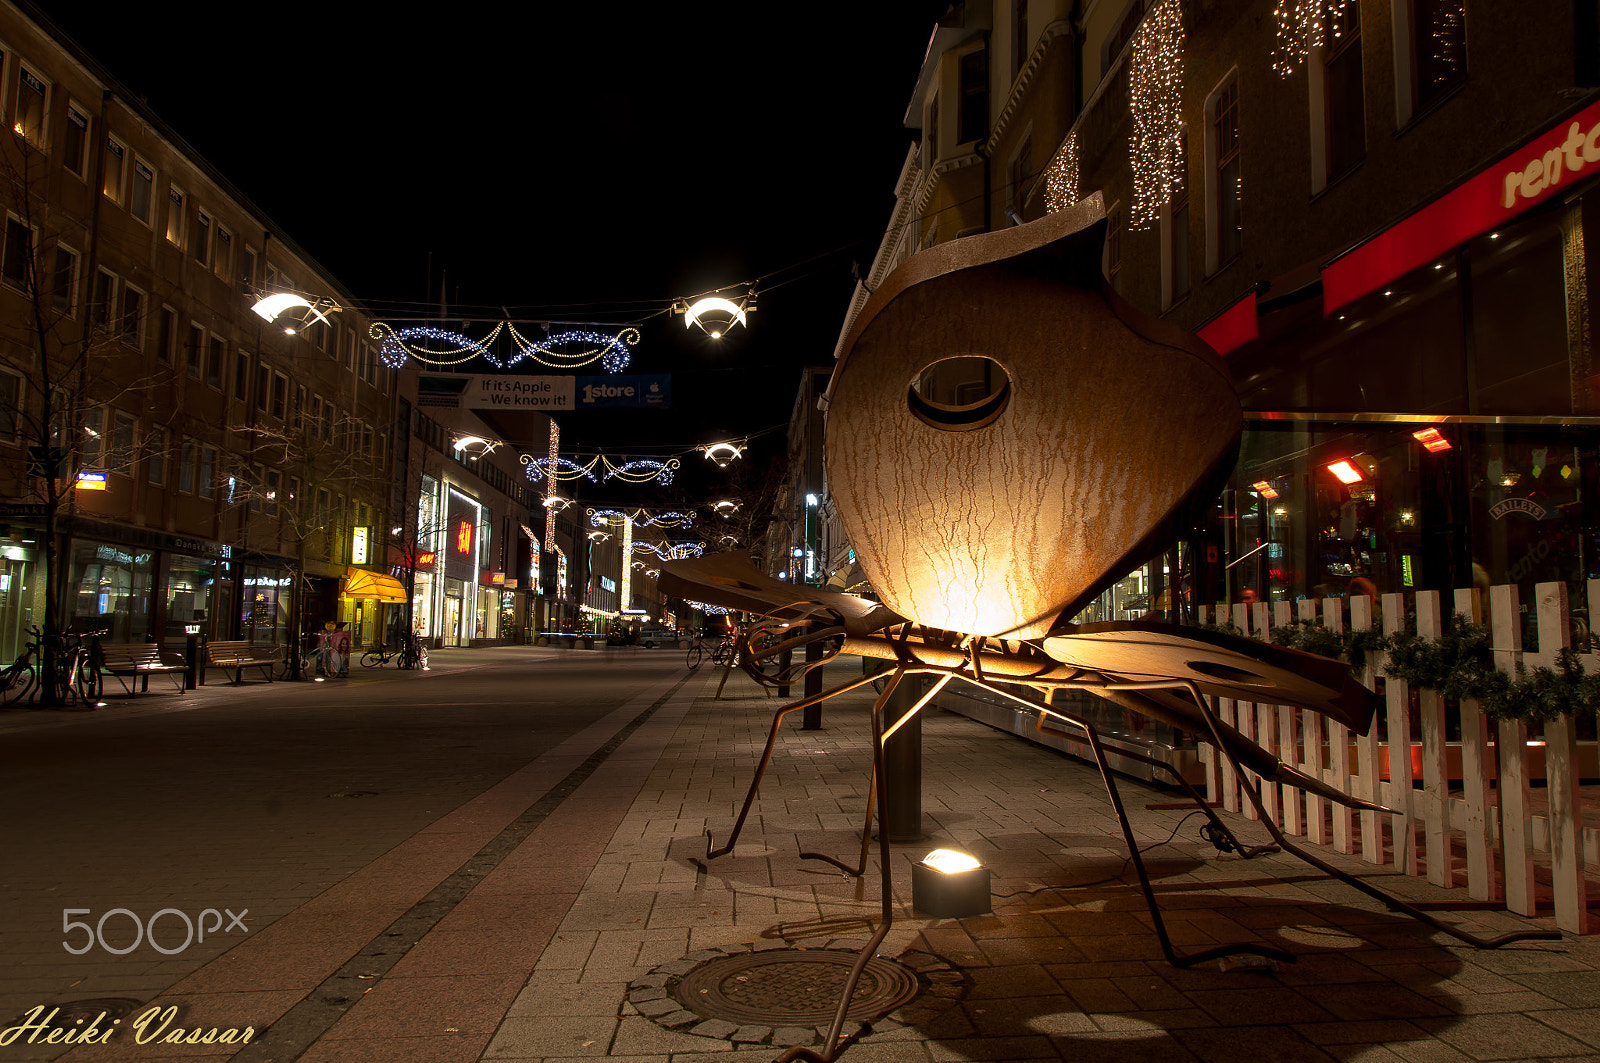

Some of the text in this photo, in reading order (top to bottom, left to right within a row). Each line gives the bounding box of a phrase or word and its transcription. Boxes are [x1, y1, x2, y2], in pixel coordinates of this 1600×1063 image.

[481, 380, 551, 395] If it's Apple
[581, 384, 635, 404] 1store
[491, 394, 511, 406] We
[513, 394, 550, 406] know
[552, 394, 567, 406] it!
[1492, 499, 1544, 518] BAILEYS
